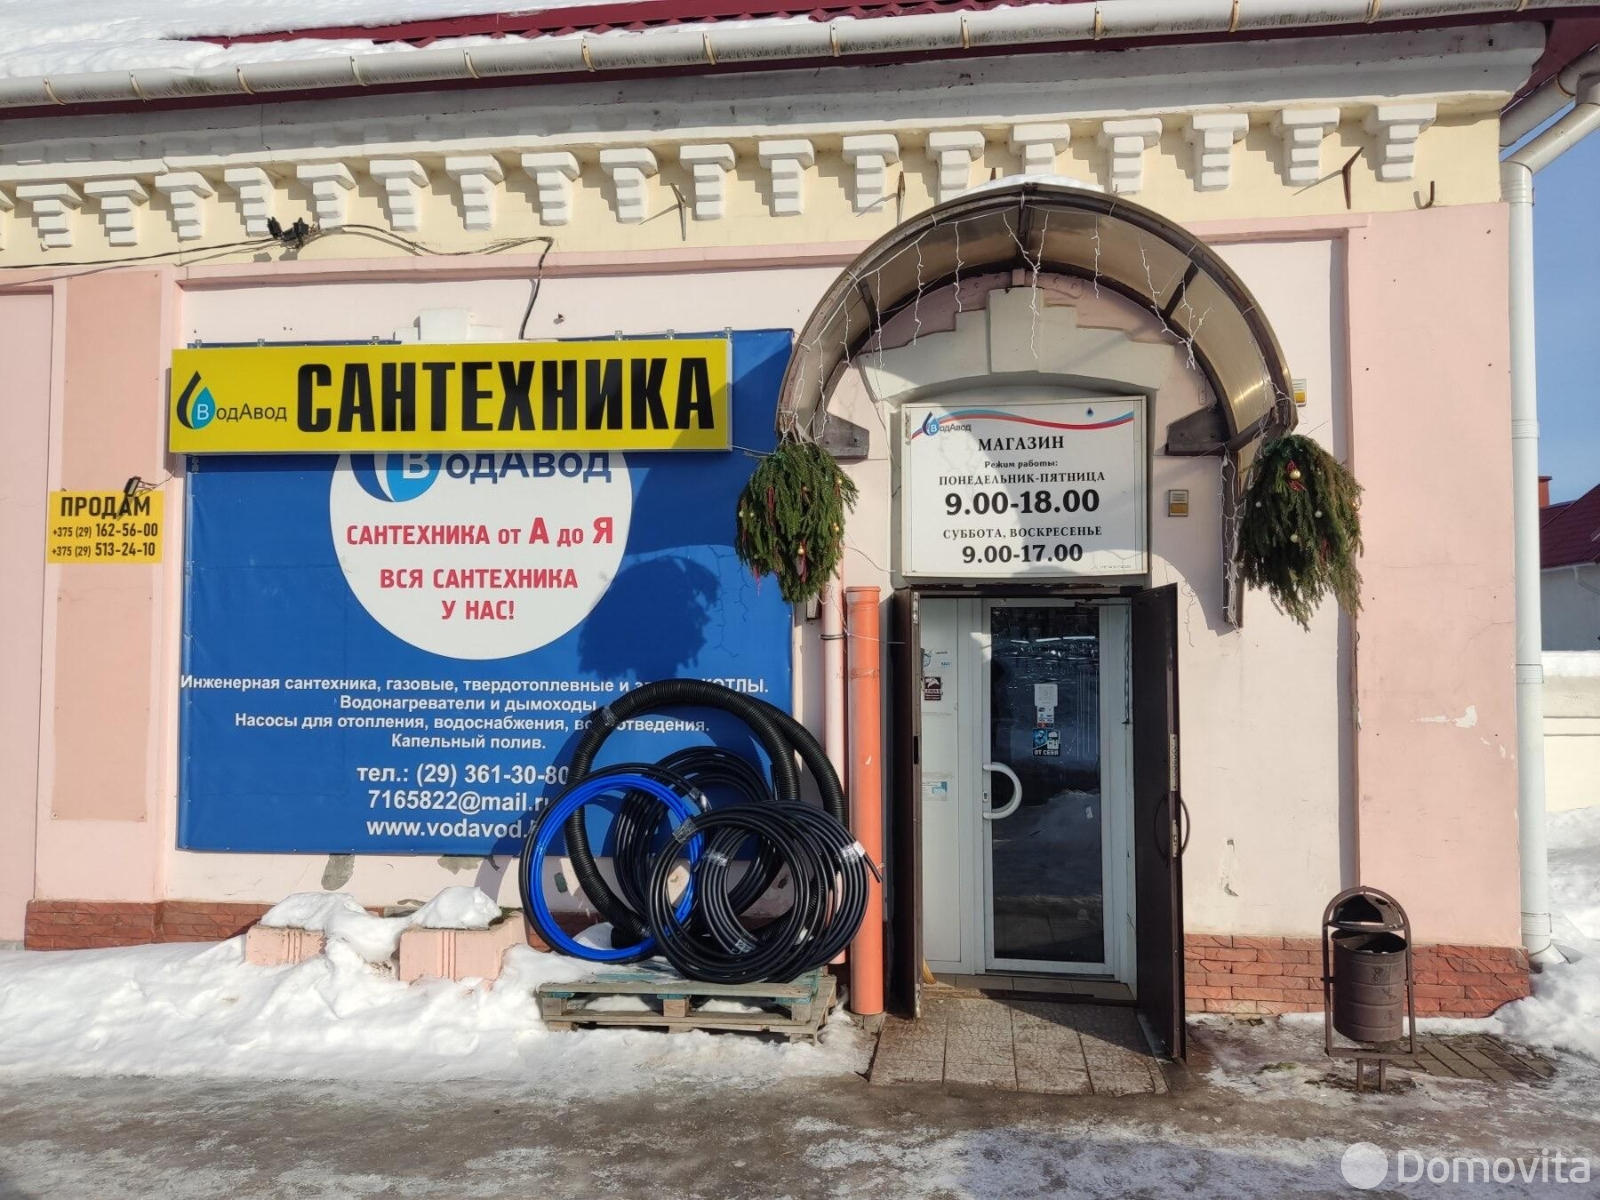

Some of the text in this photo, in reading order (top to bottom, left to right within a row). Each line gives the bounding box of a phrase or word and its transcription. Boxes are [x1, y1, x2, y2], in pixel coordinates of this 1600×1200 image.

[297, 357, 714, 433] САНТЕХНИКА
[196, 403, 287, 422] ВодАвод
[978, 435, 1064, 451] МАГАЗИН
[402, 451, 612, 485] ВодАвод
[984, 460, 1058, 470] Режим работы:
[939, 471, 1105, 486] ПОНЕДЕЛЬНИК-ПЯТНИЦА
[60, 495, 151, 519] ПРОДАМ
[945, 489, 1100, 515] 9.00-18.00
[53, 522, 158, 538] +375 (29) 162-56-00
[346, 516, 613, 547] САНТЕХНИКА от А до Я
[943, 526, 1102, 540] СУББОТА, ВОСКРЕСЕНЬЕ
[52, 542, 155, 558] +375 (29) 513-24-10
[962, 543, 1083, 564] 9.00-17.00
[380, 568, 578, 589] ВСЯ САНТЕХНИКА
[441, 600, 515, 620] У НАС!
[181, 675, 280, 691] Инженерная
[285, 678, 381, 692] сантехника,
[386, 679, 458, 692] газовые,
[619, 681, 629, 692] и
[701, 678, 768, 693] ОТЛЫ.
[340, 695, 485, 712] Водонагреватели
[492, 700, 499, 711] и
[235, 713, 710, 734] Насосы для отопления, водоснабжения, воотведения.
[392, 733, 546, 750] Капельный полив.
[357, 763, 569, 787] тел.: (29) 361-30-80
[367, 819, 536, 839] www.vodavod.
